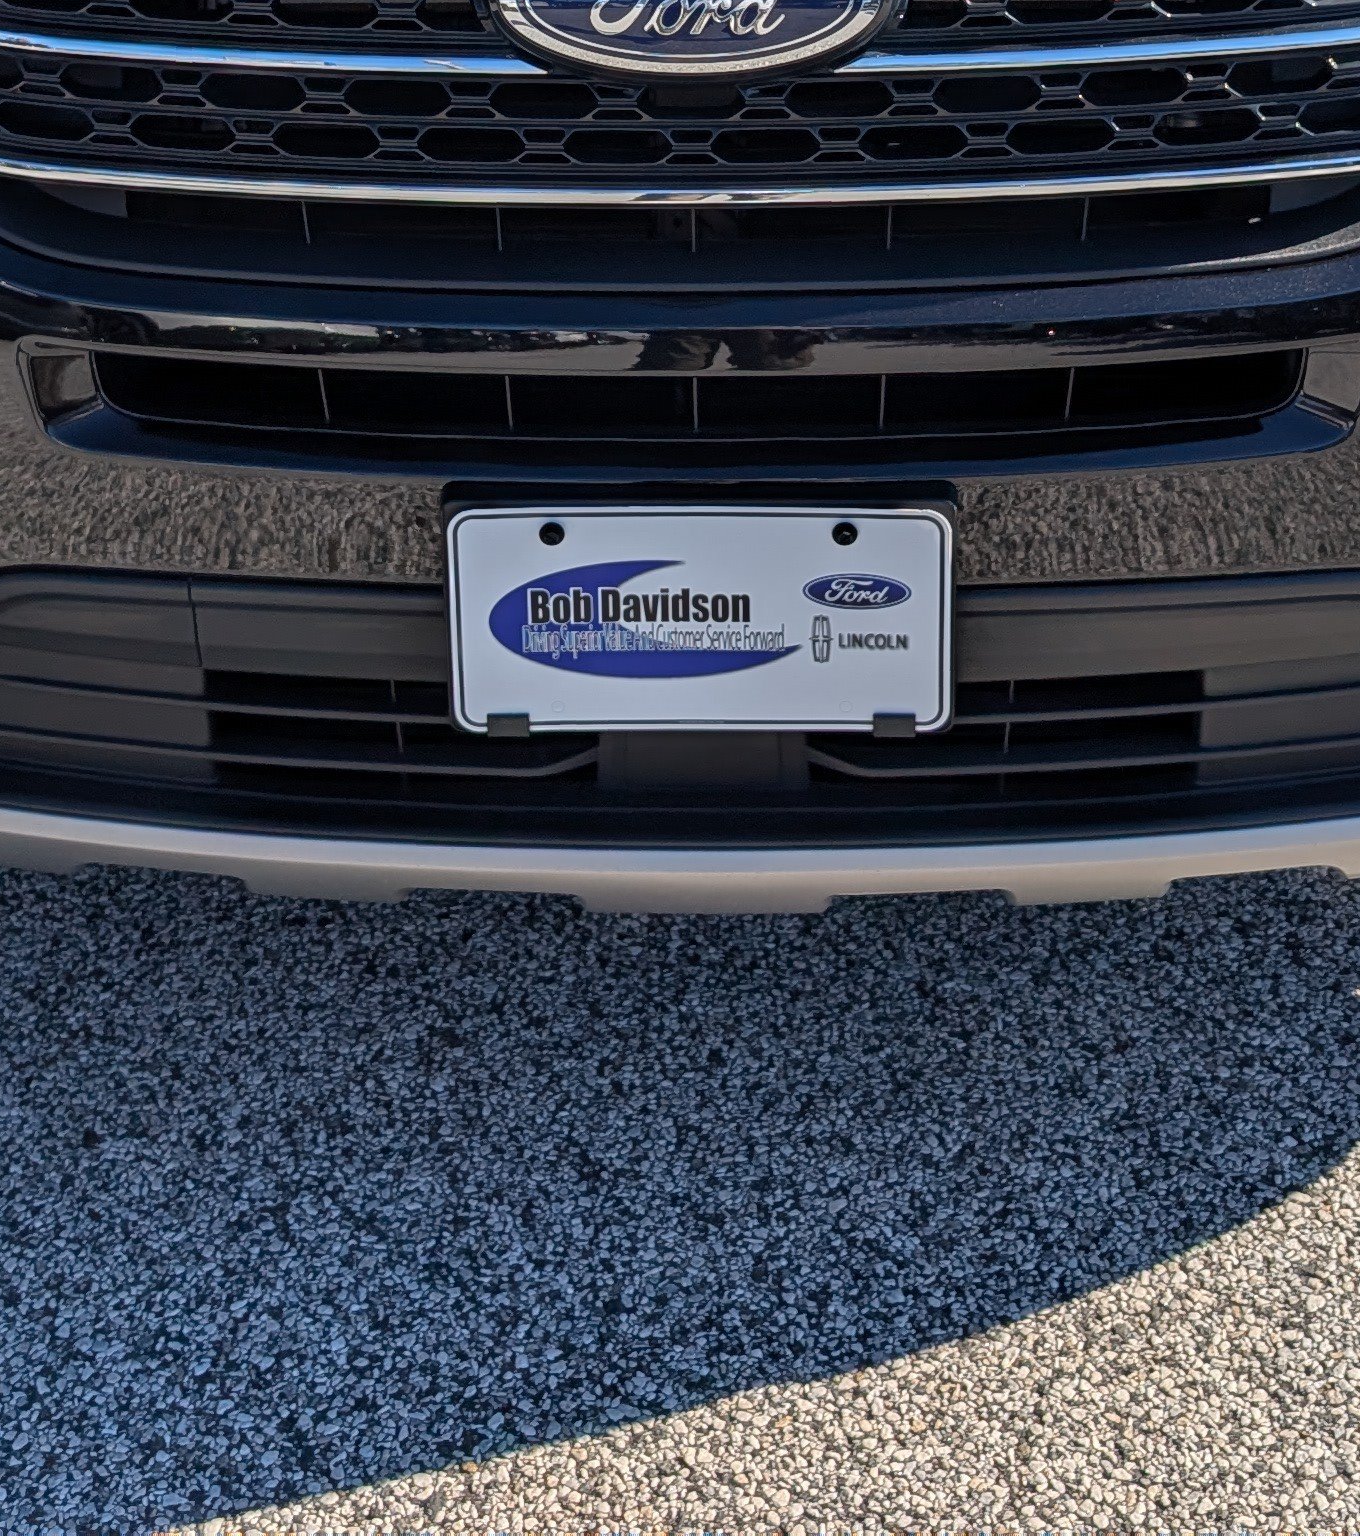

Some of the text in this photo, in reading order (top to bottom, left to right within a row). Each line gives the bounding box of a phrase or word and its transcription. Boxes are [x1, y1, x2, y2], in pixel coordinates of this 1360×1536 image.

[824, 578, 889, 604] Ford
[529, 587, 751, 624] Bob Davidson
[655, 623, 704, 651] Customer
[705, 623, 742, 650] Service
[743, 622, 785, 651] Forward
[838, 633, 909, 650] LINCOLN
